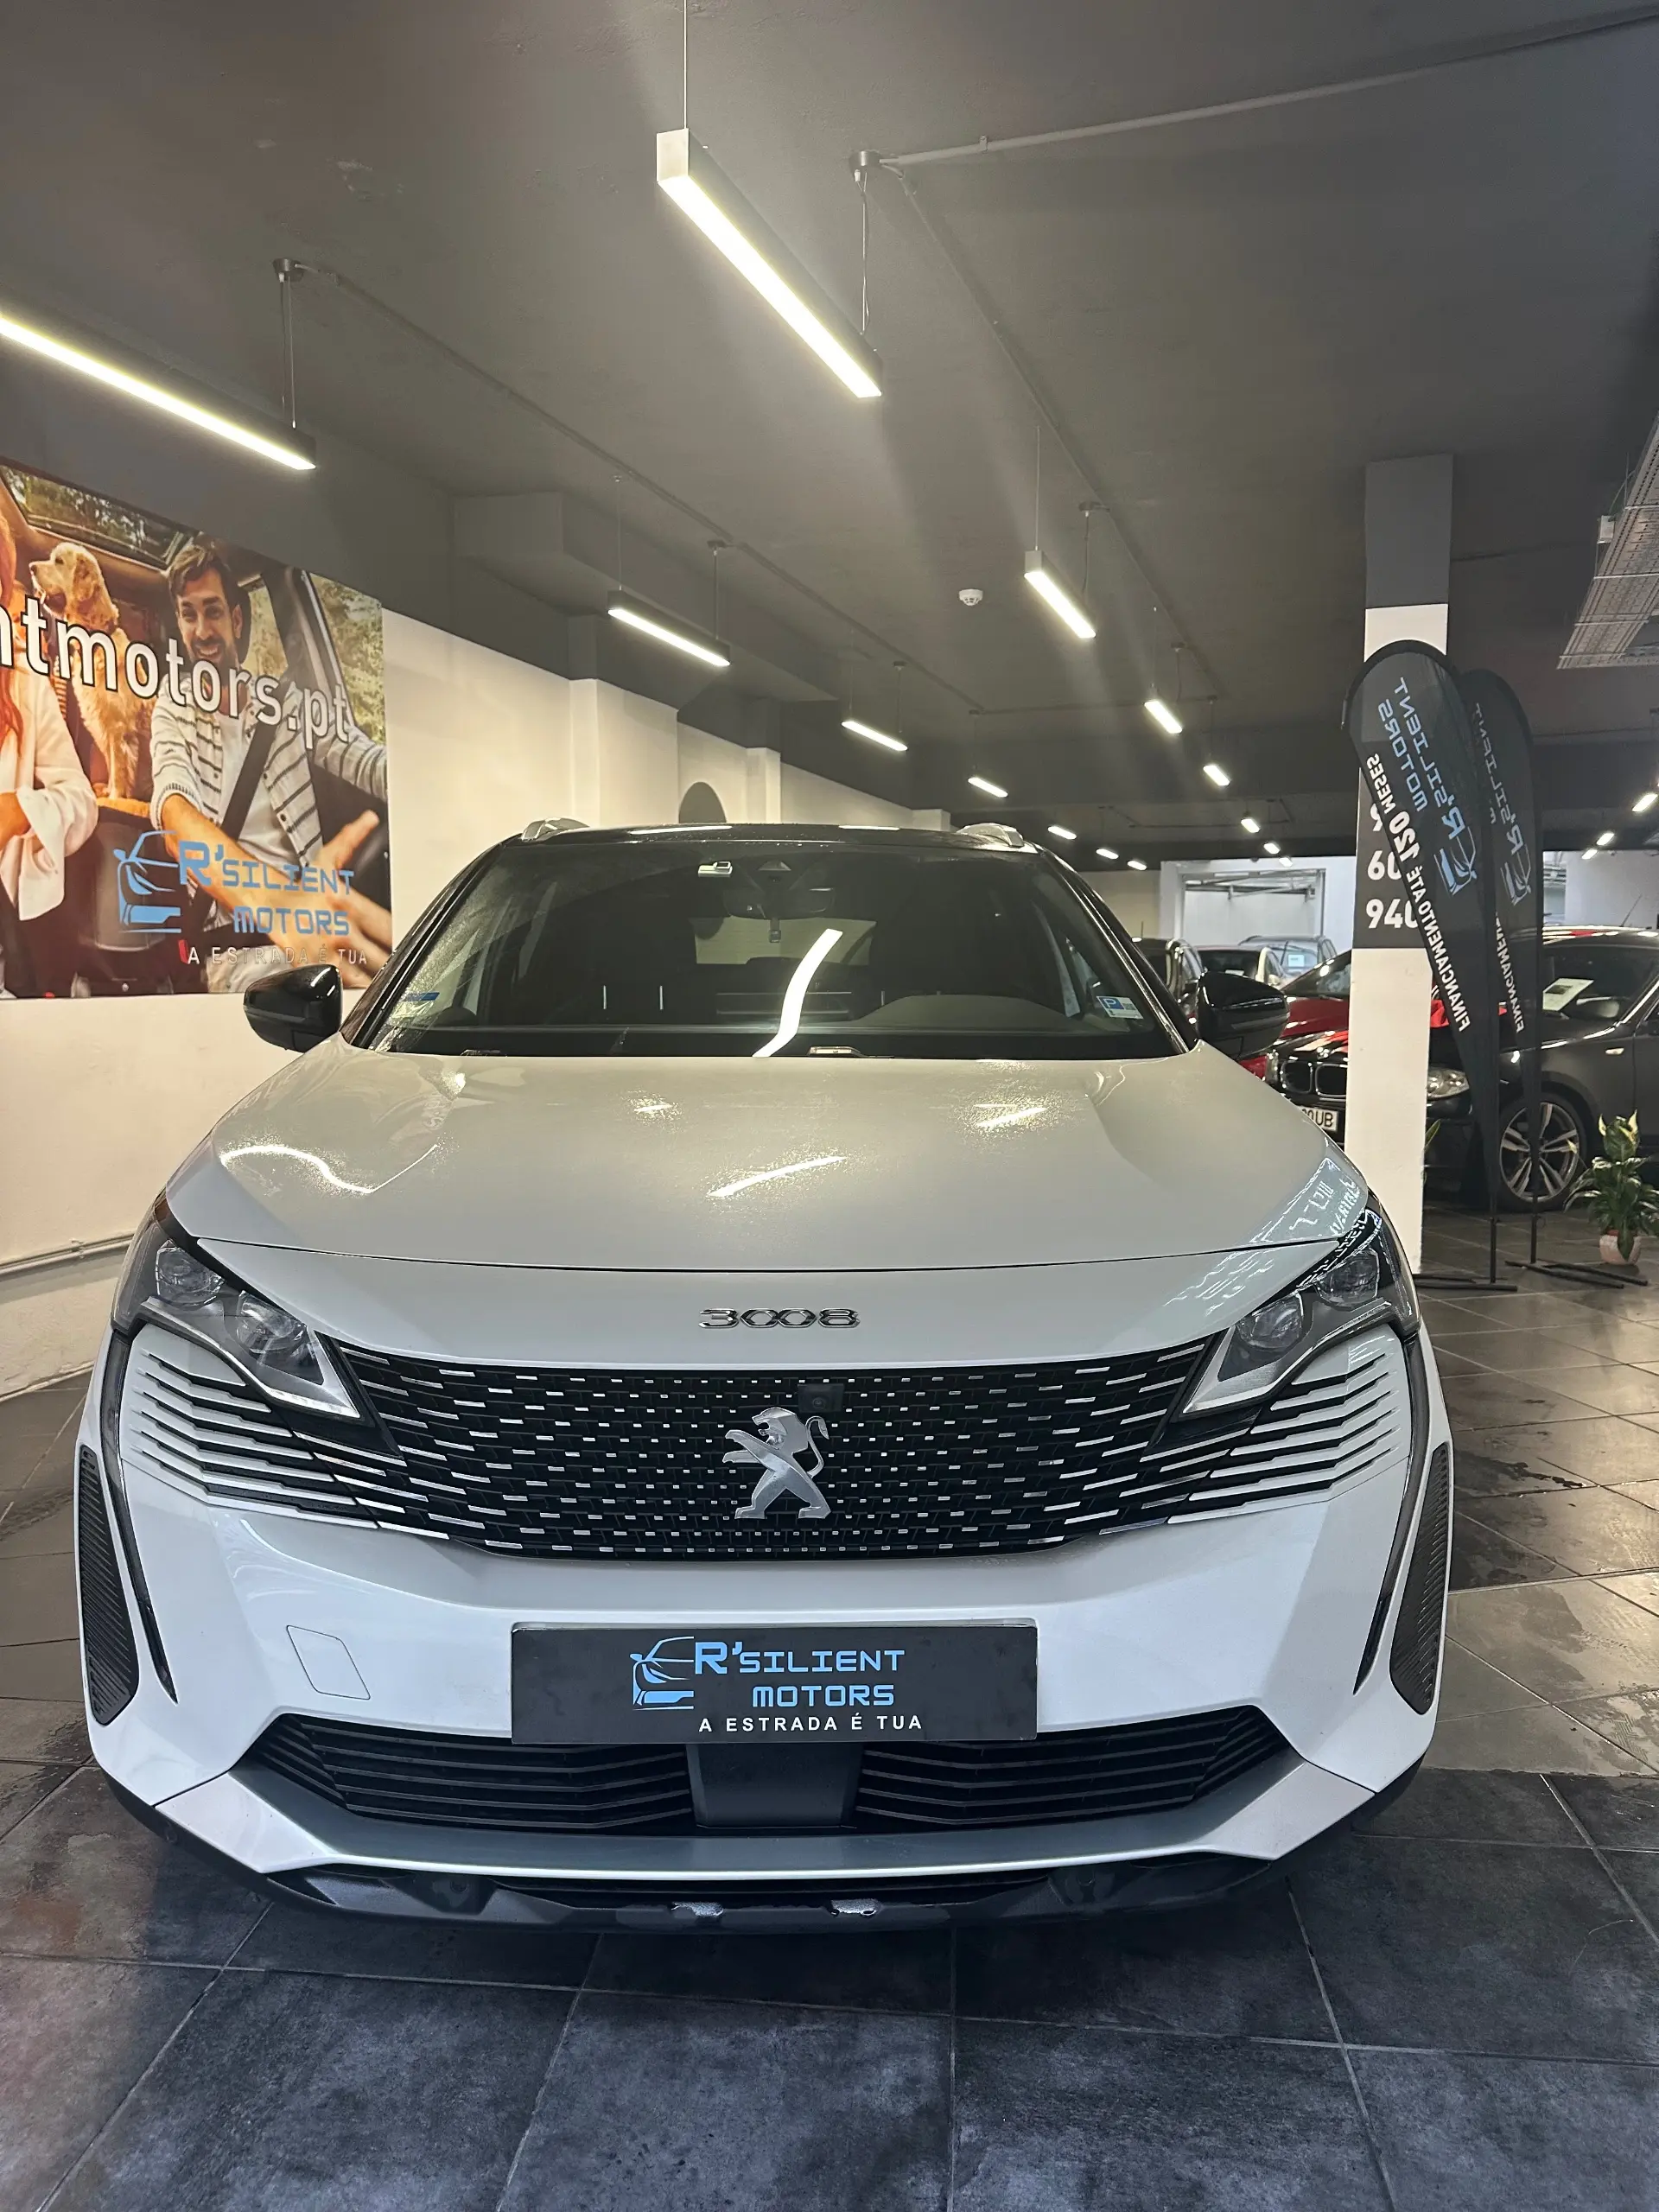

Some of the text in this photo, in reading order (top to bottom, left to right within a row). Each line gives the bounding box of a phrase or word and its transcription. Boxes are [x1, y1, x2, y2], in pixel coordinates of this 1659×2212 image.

[179, 840, 355, 896] R'SILIENT
[233, 906, 350, 937] MOTORS
[187, 945, 200, 965] A
[211, 946, 308, 965] ESTRADA
[338, 948, 368, 965] TUA
[697, 1307, 861, 1329] 3008
[695, 1641, 905, 1675] R'SILIENT
[752, 1684, 895, 1707] MOTORS
[698, 1712, 923, 1732] A ESTRADA É TUA
